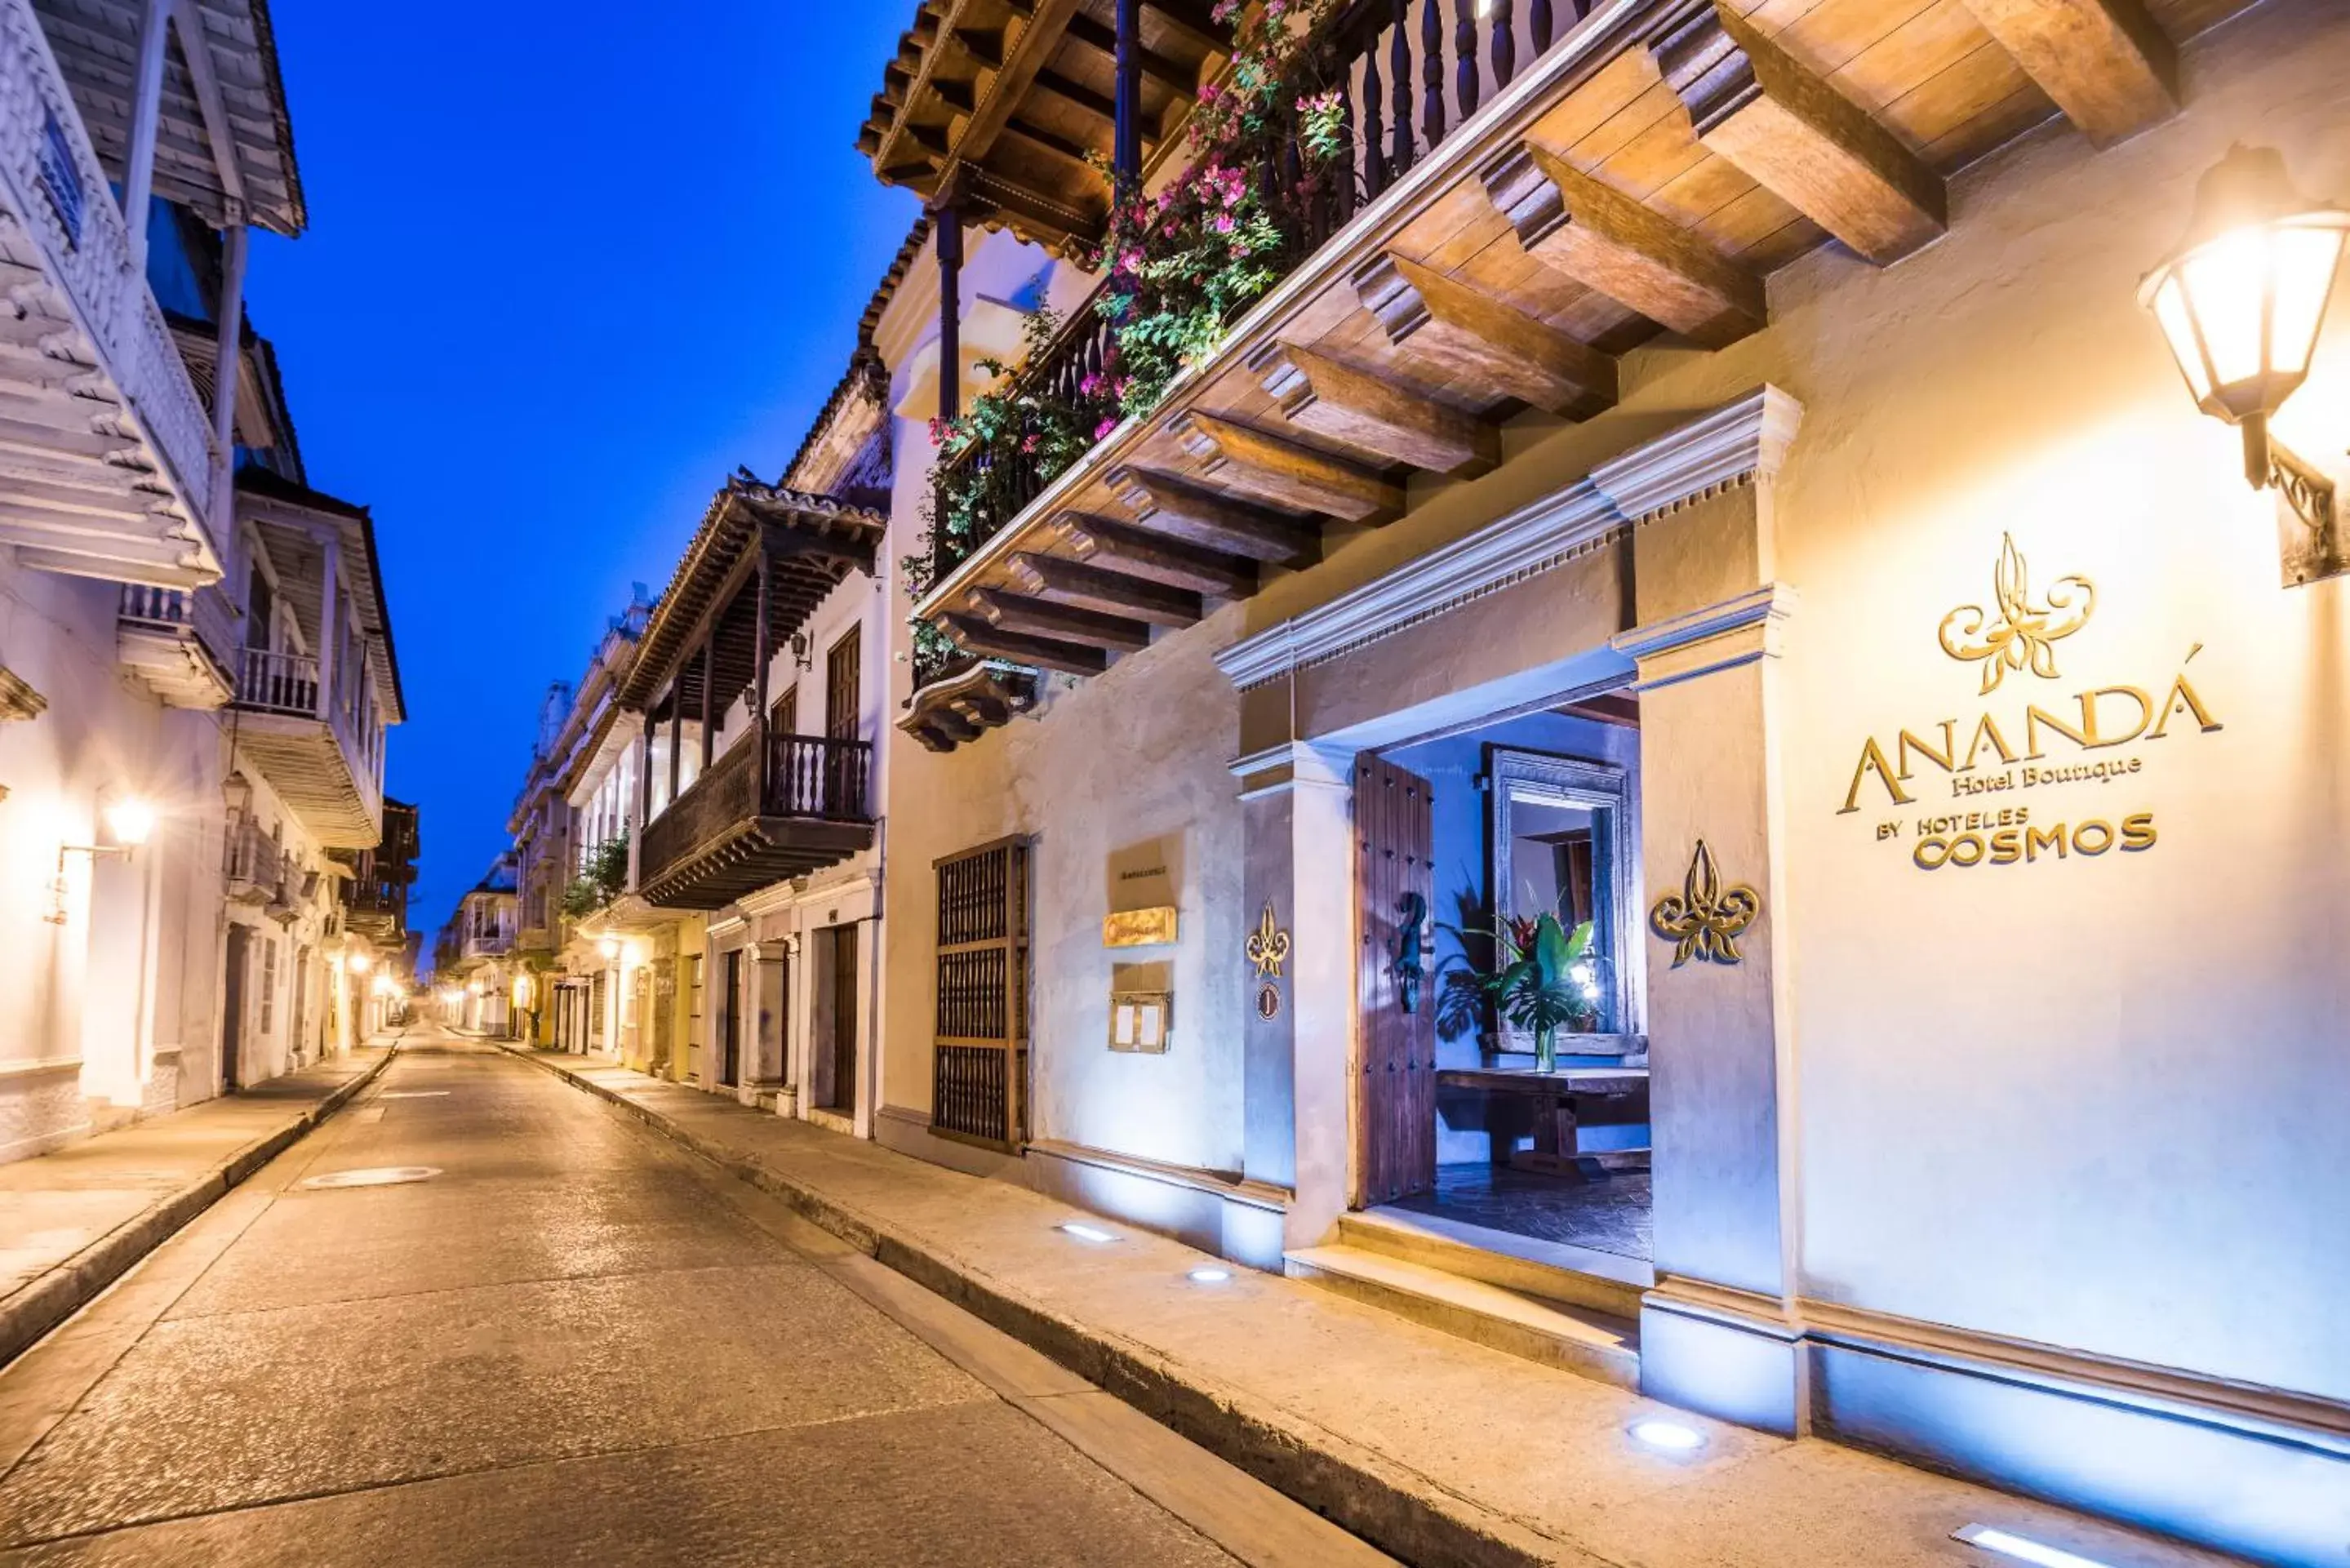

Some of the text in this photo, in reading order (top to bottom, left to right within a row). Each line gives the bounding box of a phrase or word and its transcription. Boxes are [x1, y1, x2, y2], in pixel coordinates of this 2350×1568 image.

[1836, 641, 2223, 815] ANANDÁ
[1952, 757, 2143, 797] Hotel Boutique
[1877, 806, 2031, 841] BY HOTELES
[1912, 812, 2158, 871] COSMOS
